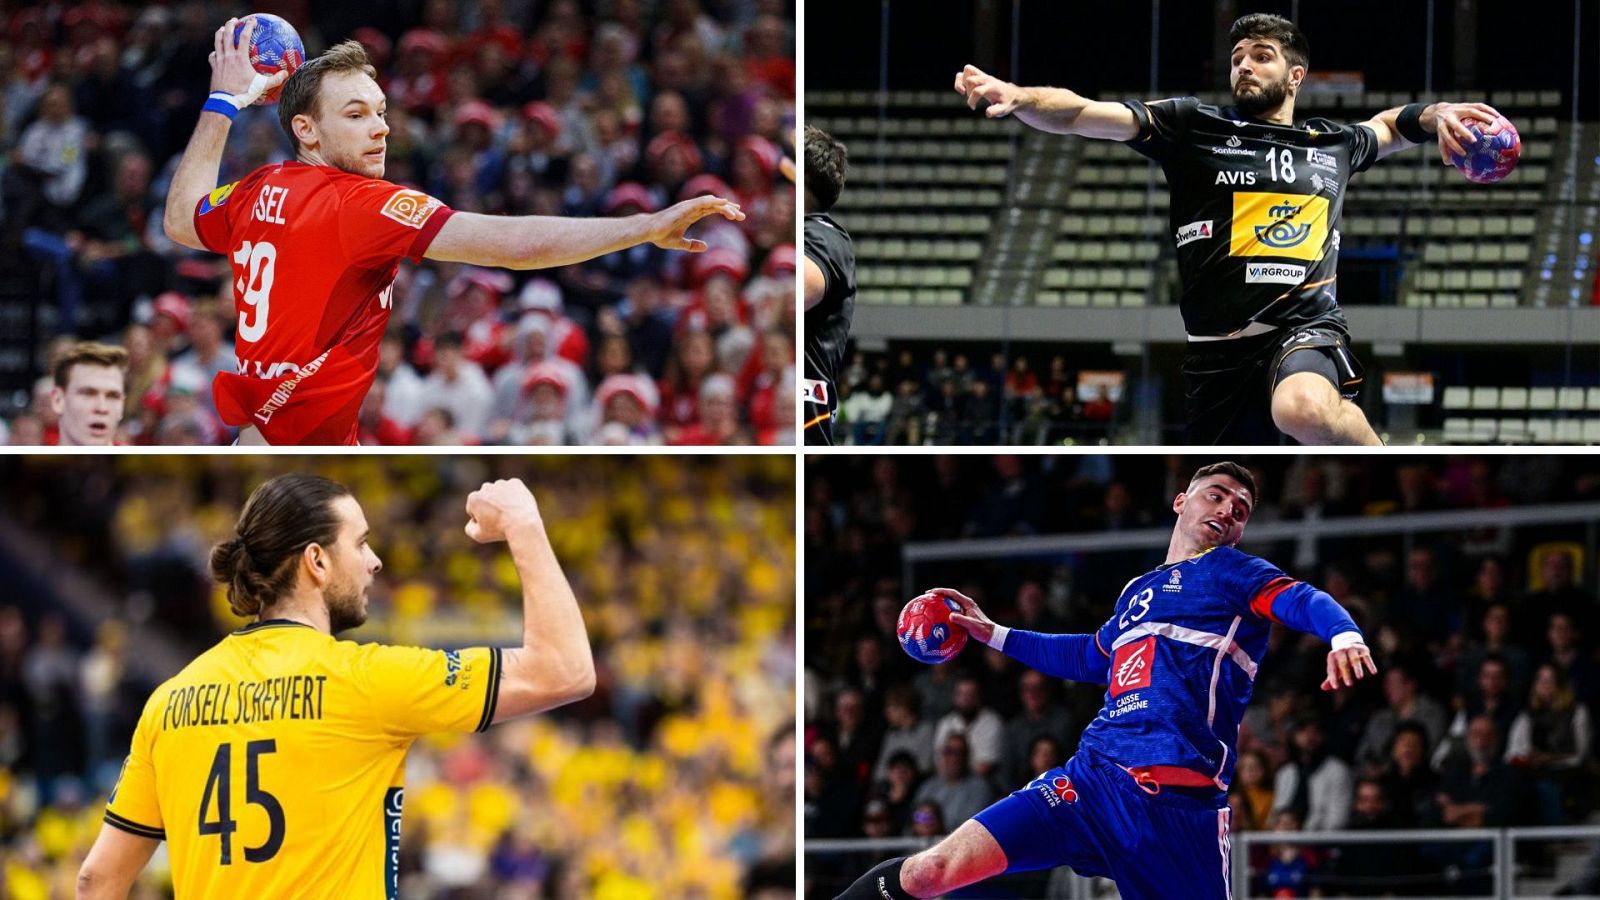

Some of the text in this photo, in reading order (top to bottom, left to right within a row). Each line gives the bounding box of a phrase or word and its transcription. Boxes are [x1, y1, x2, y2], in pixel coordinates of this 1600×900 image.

[1211, 146, 1257, 156] Santander
[1265, 146, 1296, 184] 18
[1214, 170, 1256, 185] AVIS
[251, 184, 289, 225] SEL
[233, 240, 277, 343] 19
[1119, 587, 1154, 630] 23
[163, 683, 230, 731] FORSELL
[1116, 693, 1140, 708] CAISSE
[199, 738, 286, 865] 45
